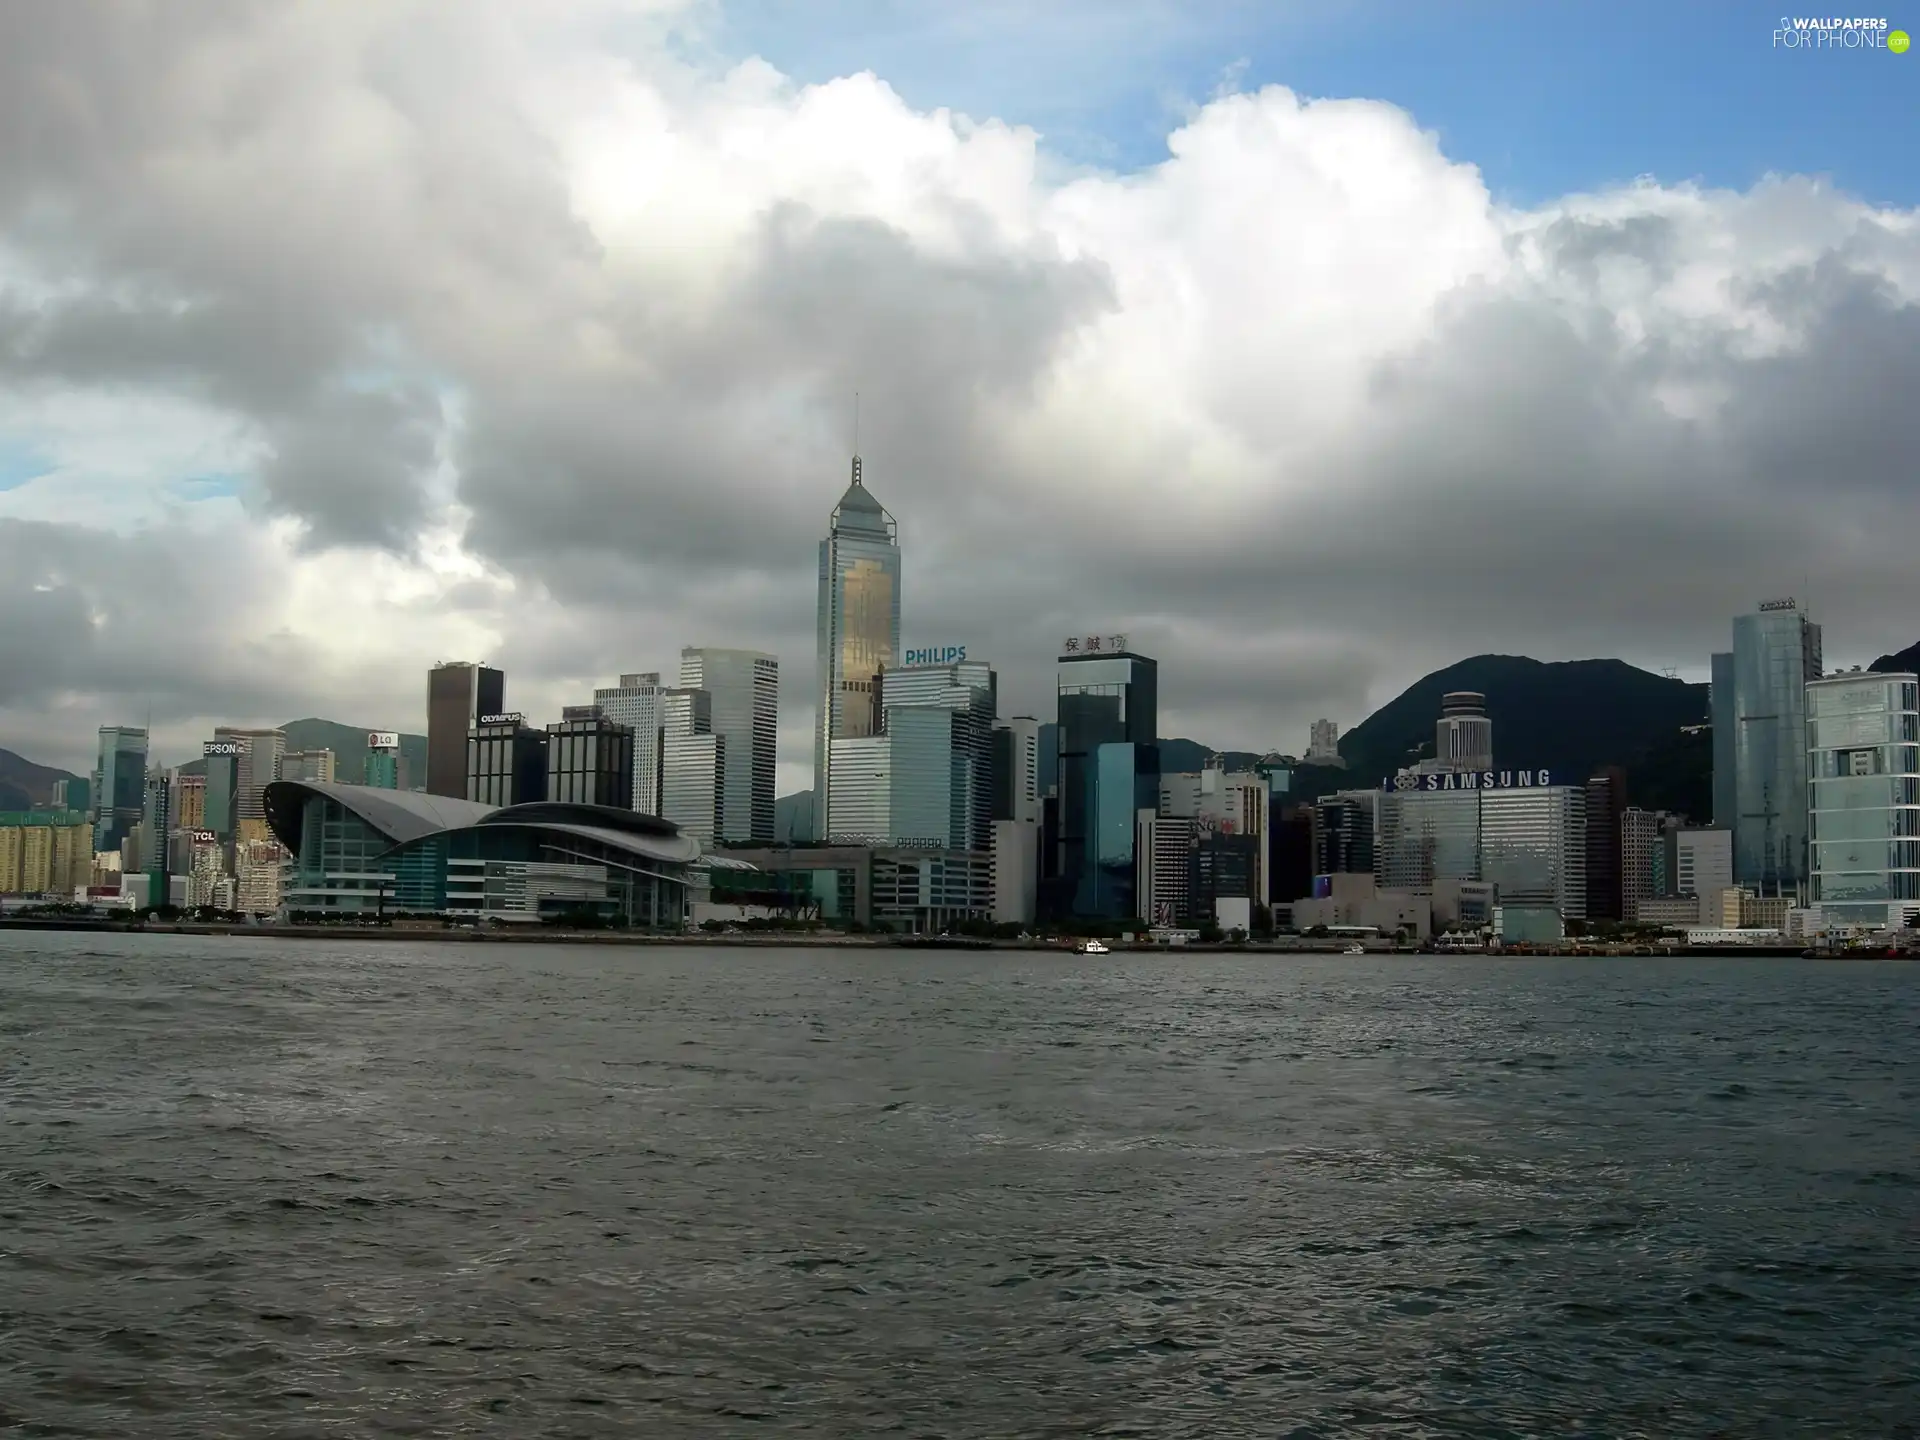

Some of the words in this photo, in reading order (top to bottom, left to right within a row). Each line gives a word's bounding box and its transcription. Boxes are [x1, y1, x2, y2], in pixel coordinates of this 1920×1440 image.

[906, 646, 966, 665] PHILIPS
[204, 744, 236, 754] EPSON
[1427, 769, 1550, 790] SAMSUNG
[194, 832, 214, 841] TCL
